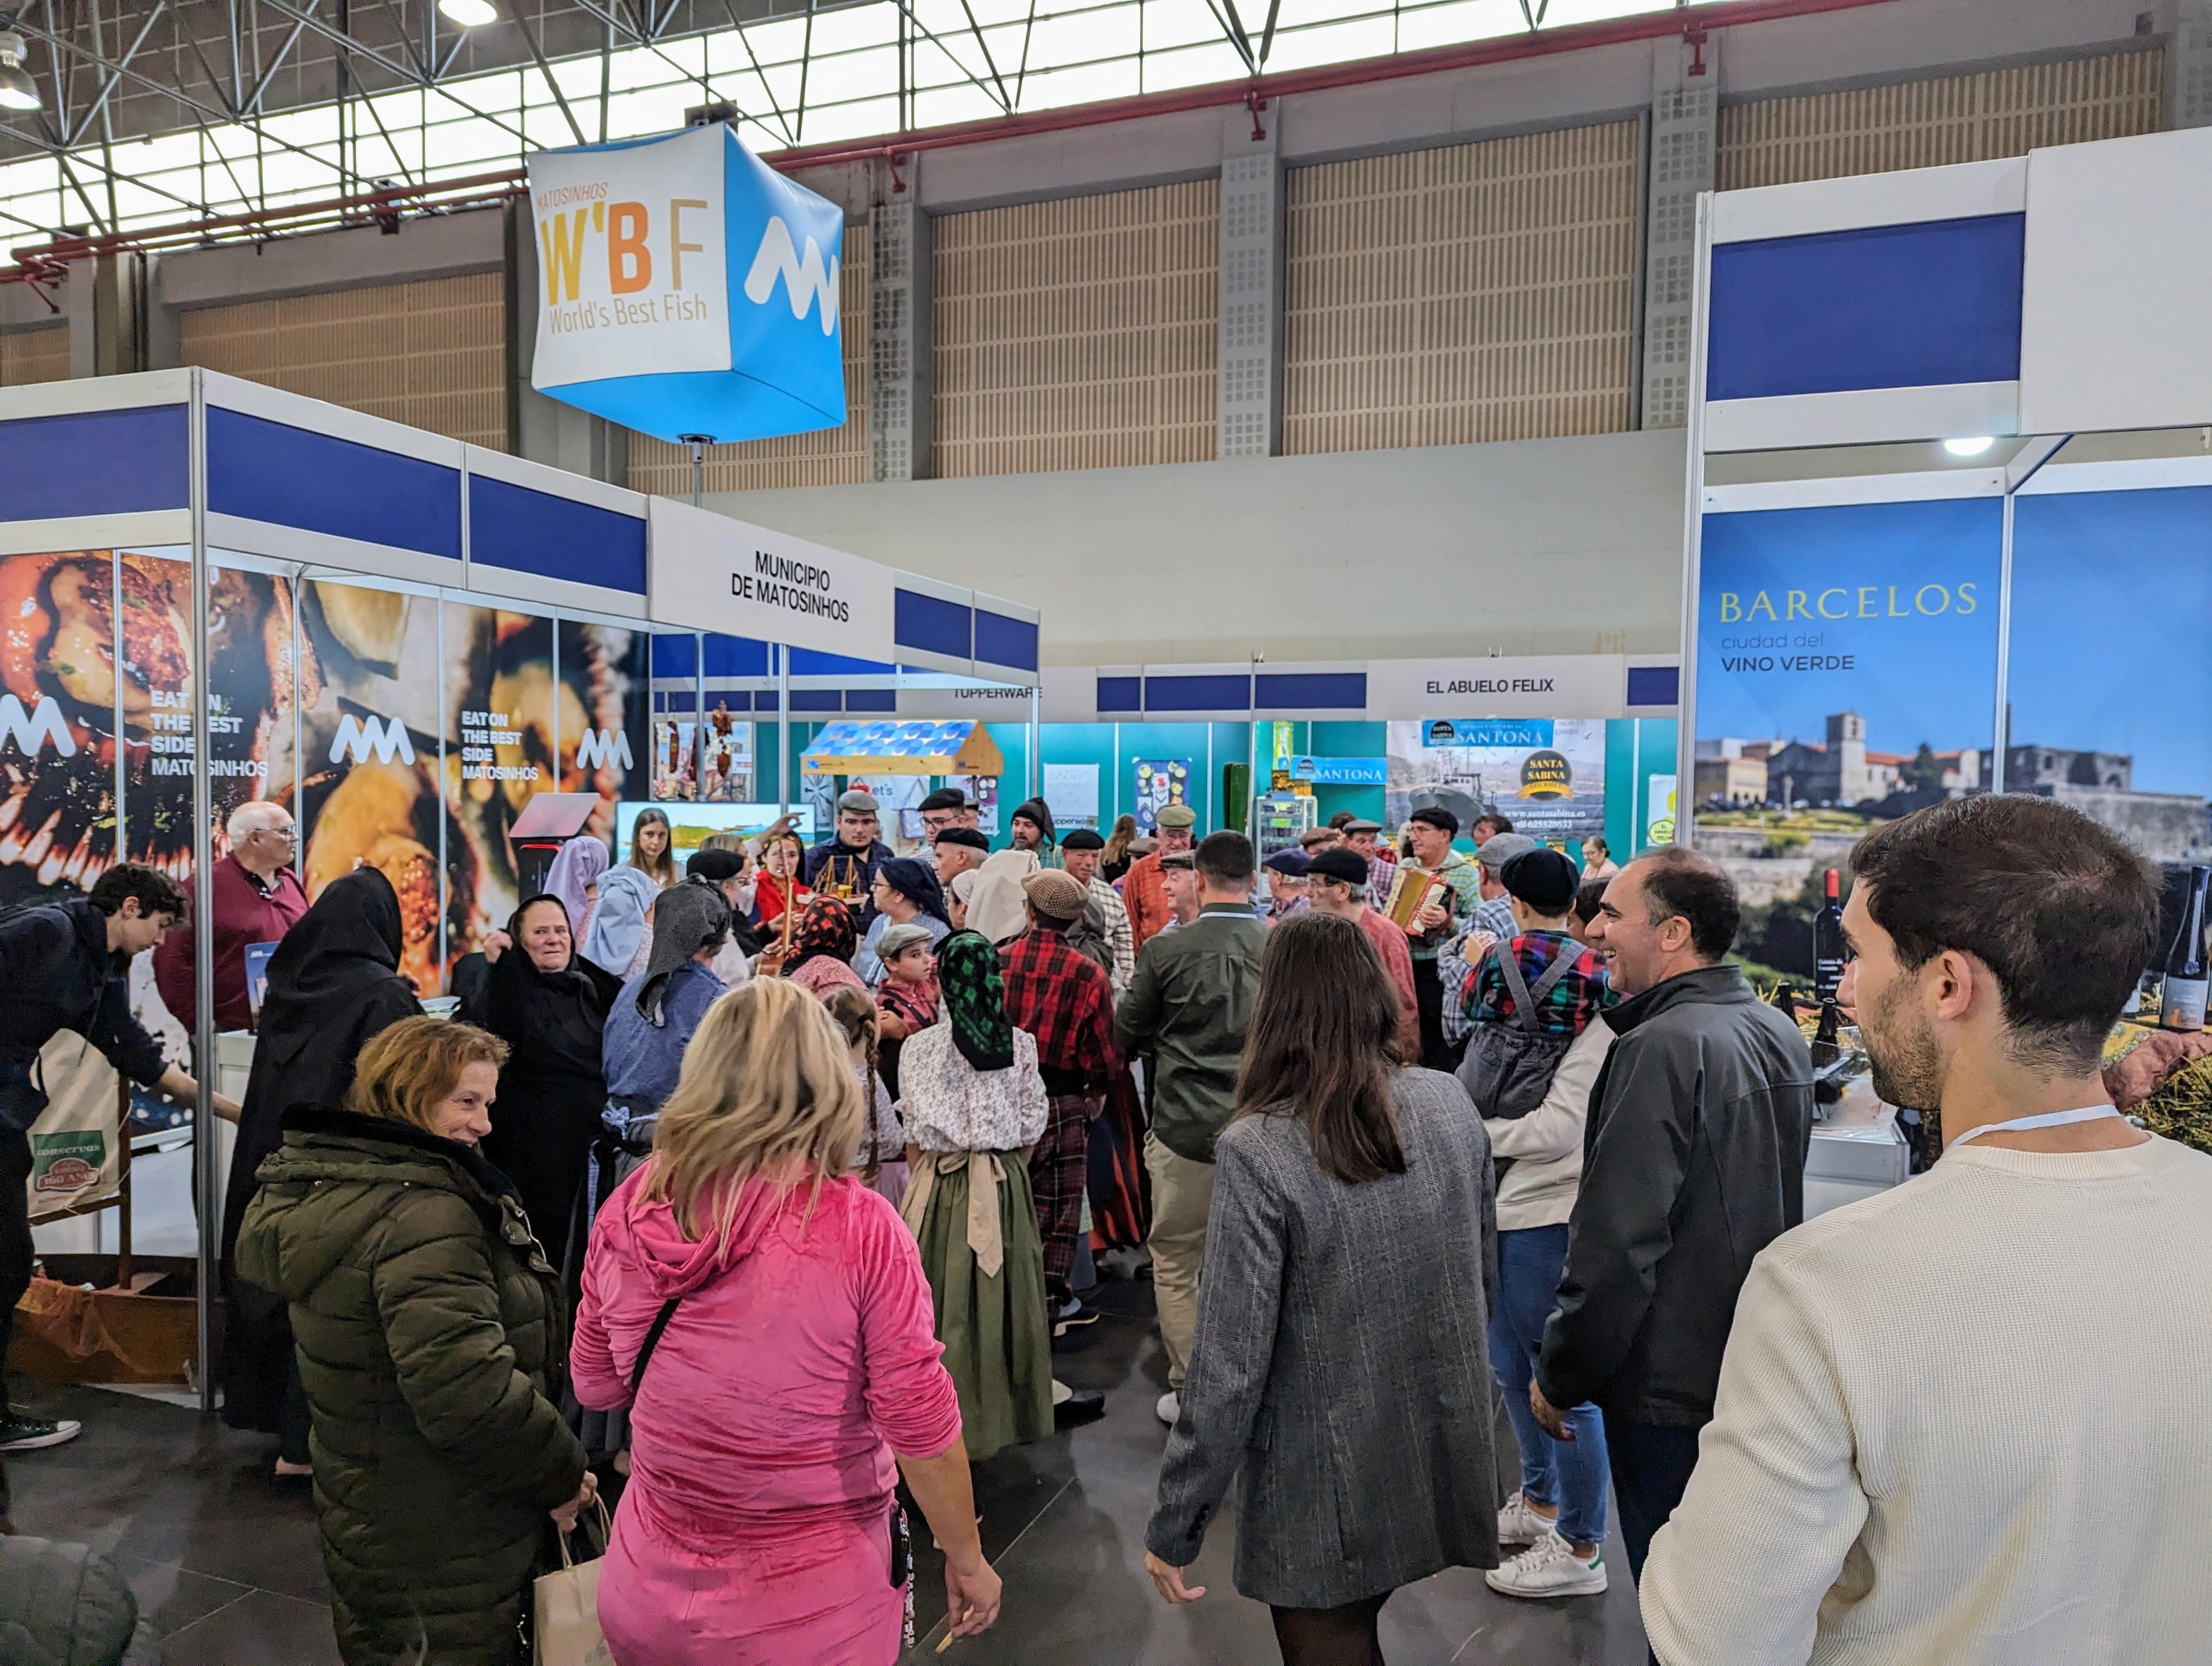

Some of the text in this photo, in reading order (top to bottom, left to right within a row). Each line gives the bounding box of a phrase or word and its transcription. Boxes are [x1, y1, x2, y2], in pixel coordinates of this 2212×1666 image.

[537, 182, 608, 213] MATOSINHOS
[550, 293, 707, 335] World's Best Fish
[755, 550, 831, 592] MUNICIPIO
[732, 573, 849, 623] DE MATOSINHOS
[1720, 582, 1977, 623] BARCELOS
[1722, 632, 1824, 650] ciudad del
[1721, 655, 1855, 672] VINO VERDE
[1426, 678, 1554, 694] EL ABUELO FELIX
[150, 689, 189, 708] EAT
[150, 713, 243, 733] THE EST
[461, 710, 508, 727] EAT ON
[150, 735, 196, 754] SIDE
[461, 729, 522, 746] THE BEST
[461, 747, 493, 762] SIDE
[1529, 759, 1564, 768] SANTA
[462, 765, 538, 780] MATOSINHOS
[1527, 771, 1565, 780] SABINA
[1504, 809, 1586, 818] www.santasabina.es
